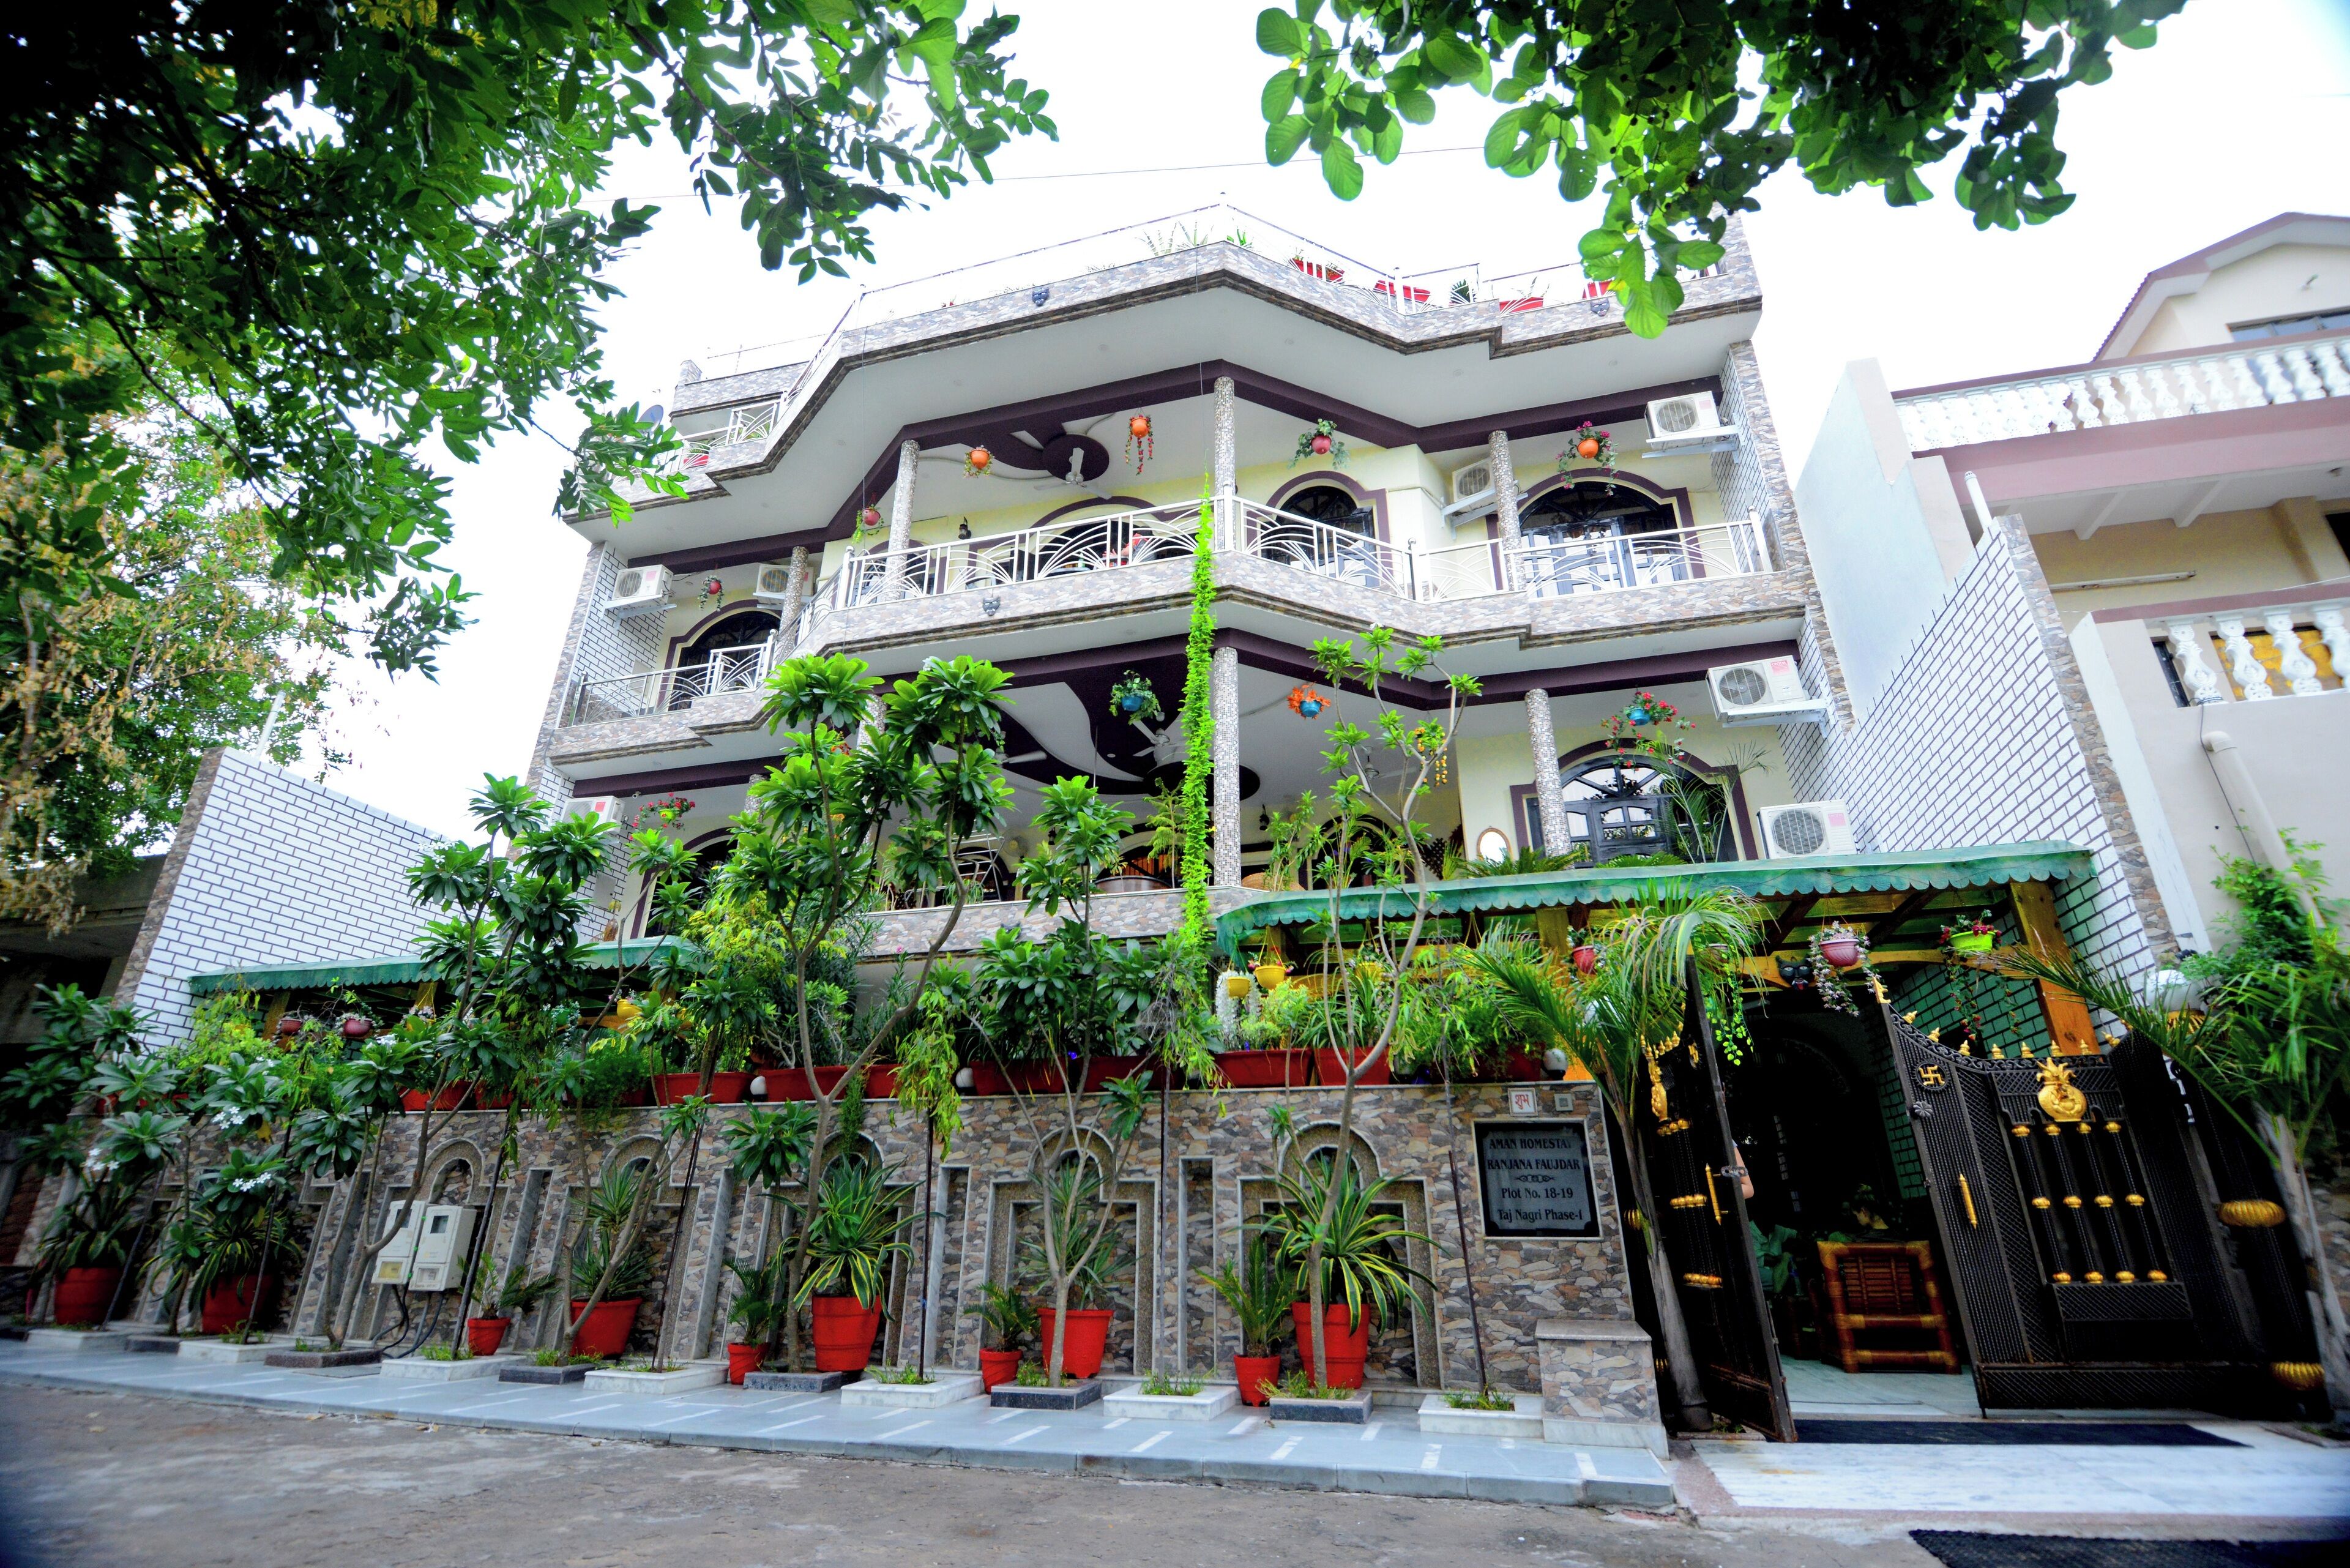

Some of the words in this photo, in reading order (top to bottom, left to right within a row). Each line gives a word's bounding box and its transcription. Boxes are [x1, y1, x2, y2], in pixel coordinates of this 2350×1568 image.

[1515, 1094, 1531, 1110] शुभ
[1489, 1138, 1516, 1149] AMAN
[1487, 1159, 1532, 1170] RANJANA
[1535, 1159, 1581, 1170] FAUJDAR
[1501, 1187, 1521, 1198] Plot
[1525, 1187, 1541, 1198] No.
[1544, 1187, 1573, 1198] 18-19
[1498, 1209, 1513, 1223] Taj
[1515, 1209, 1542, 1223] Nagri
